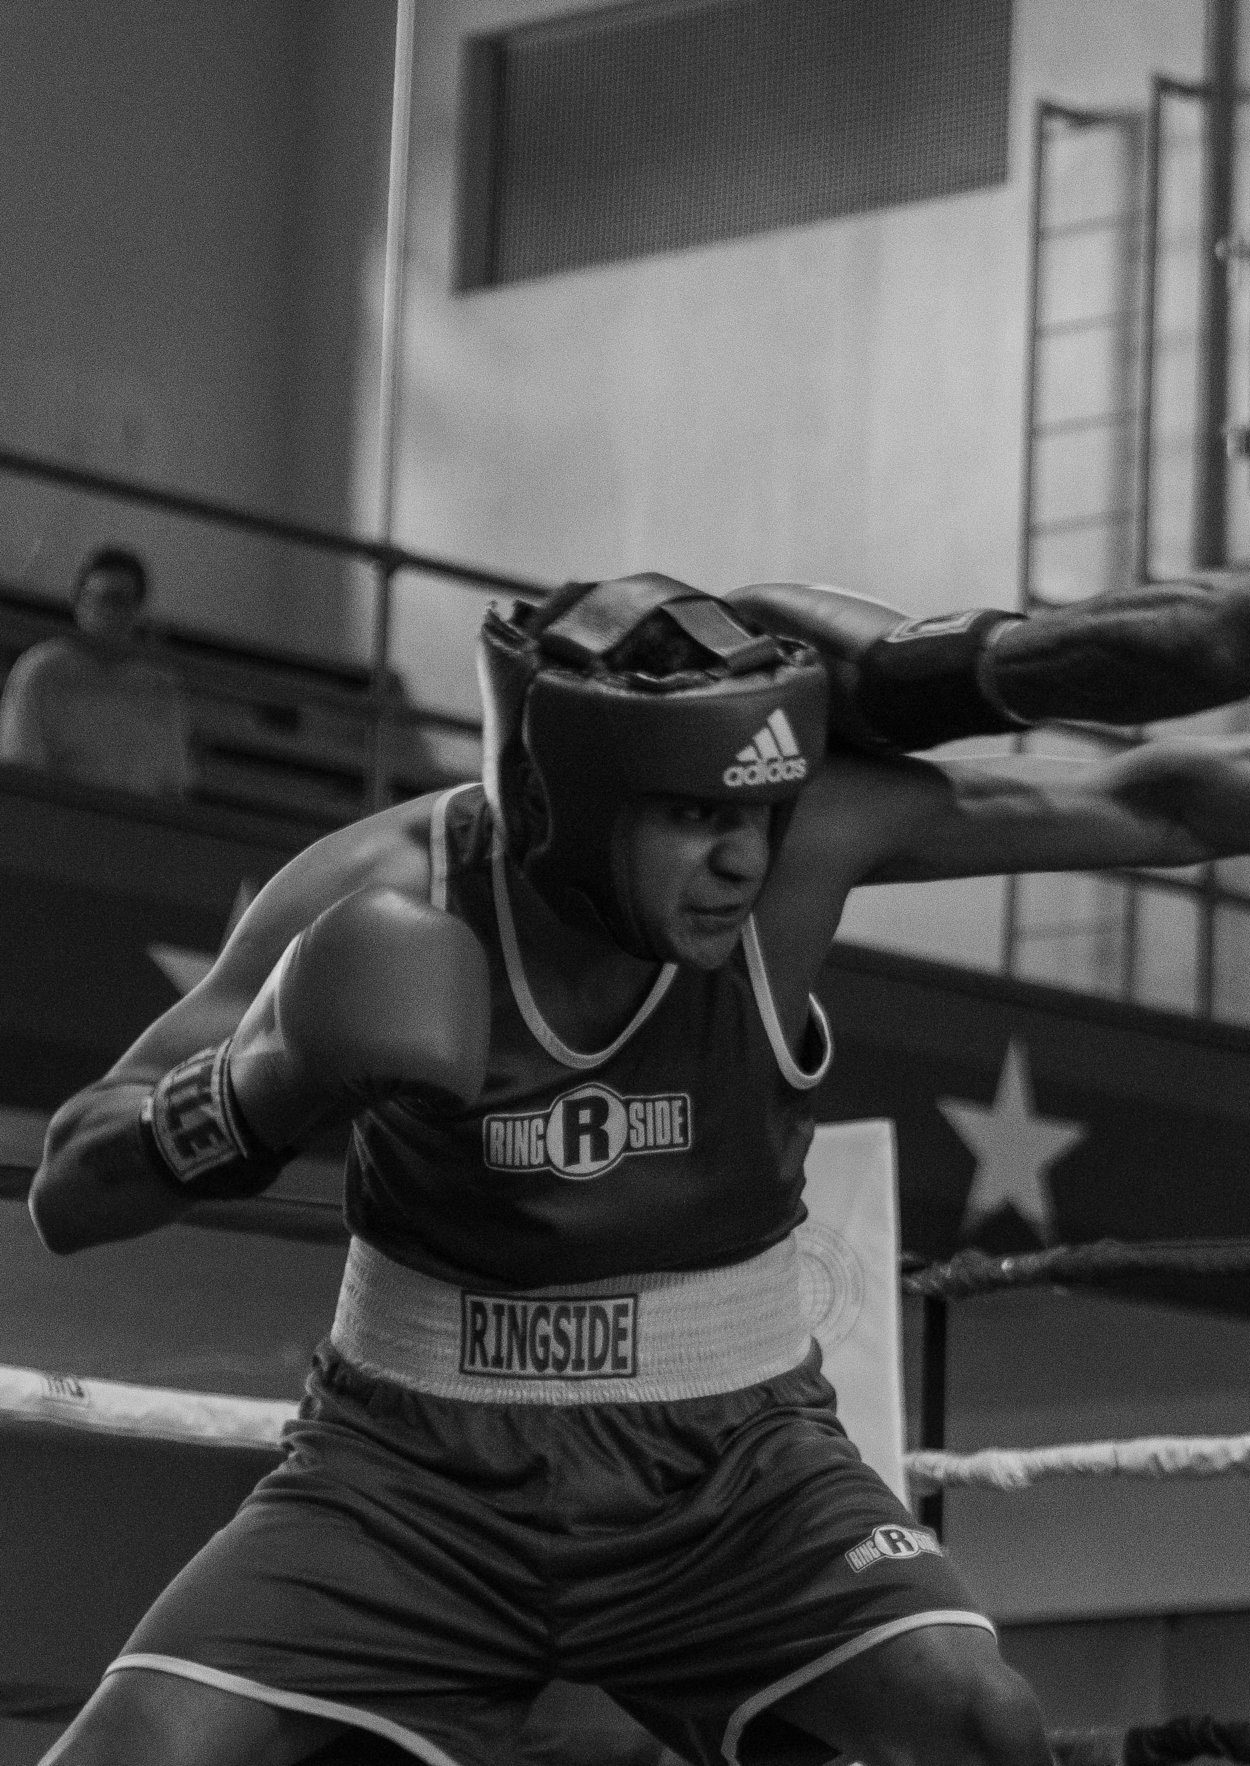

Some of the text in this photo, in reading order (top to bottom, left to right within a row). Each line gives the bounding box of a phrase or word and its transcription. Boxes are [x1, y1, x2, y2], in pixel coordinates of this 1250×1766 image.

[723, 757, 807, 787] adidas
[489, 1095, 685, 1168] RING R SIDE
[468, 1300, 629, 1373] RINGSIDE
[848, 1540, 880, 1570] RING
[879, 1529, 914, 1554] R
